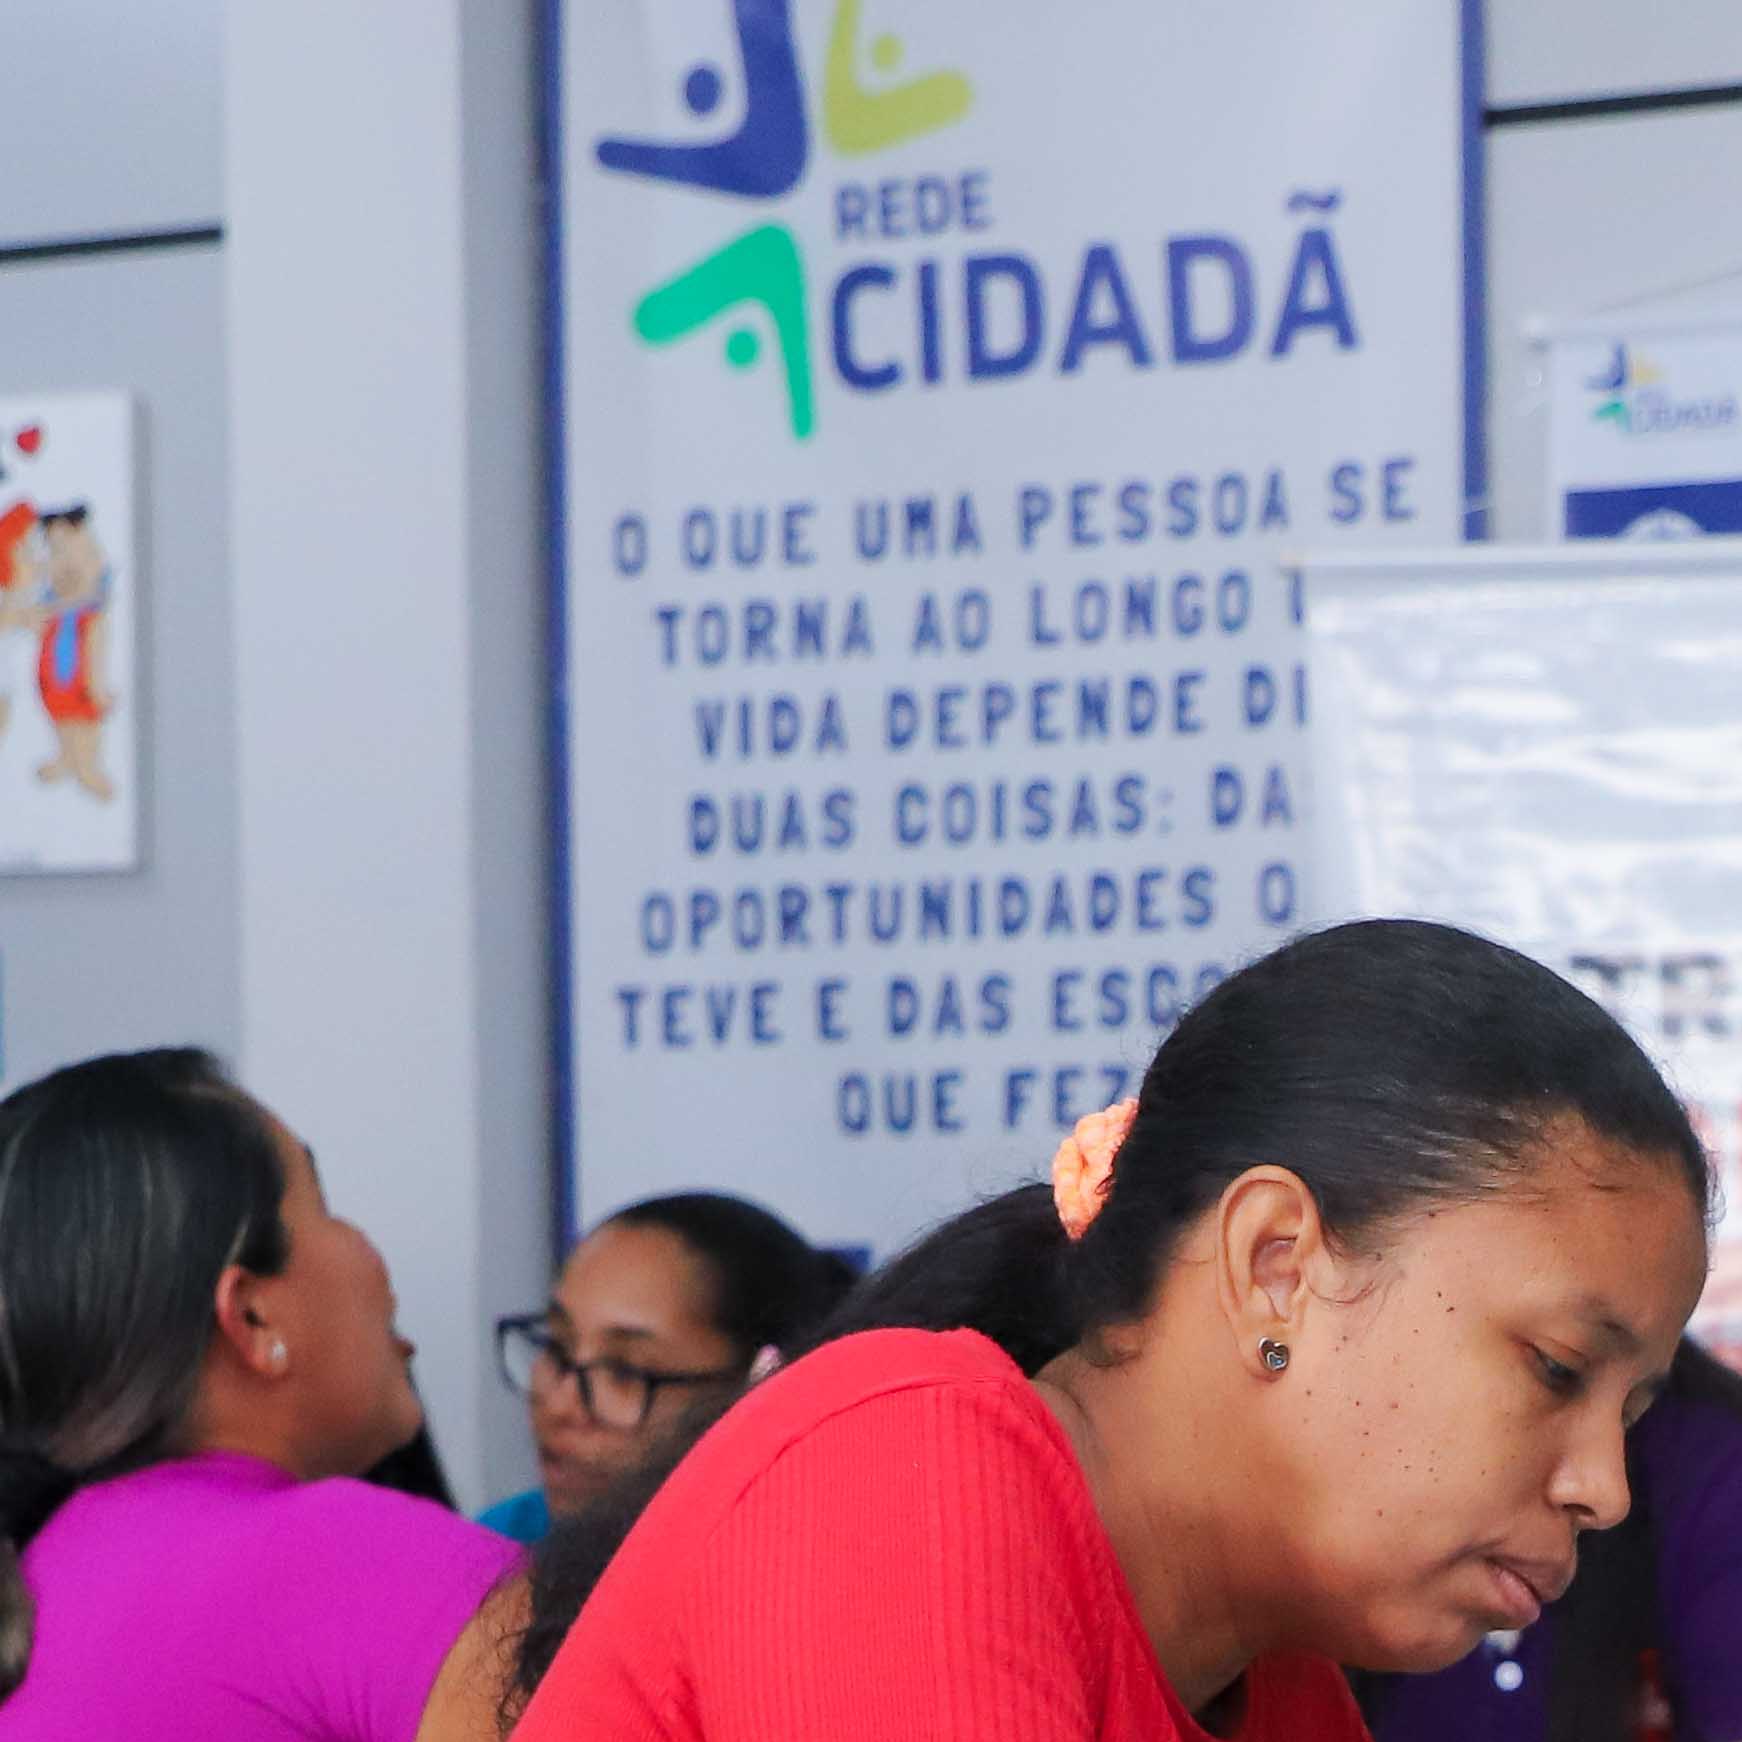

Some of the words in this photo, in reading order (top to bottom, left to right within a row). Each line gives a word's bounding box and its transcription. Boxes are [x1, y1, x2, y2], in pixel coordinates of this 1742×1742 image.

[834, 172, 995, 243] REDE
[829, 188, 1361, 395] CIDADÃ
[613, 509, 648, 577] O
[681, 497, 819, 571] QUE
[855, 488, 983, 562] UMA
[1017, 468, 1290, 552] PESSOA
[1328, 457, 1416, 524] SE
[655, 594, 876, 669] TORNA
[912, 586, 992, 656] AO
[1031, 568, 1252, 645] LONGO
[695, 688, 847, 760] VIDA
[887, 670, 1206, 754] DEPENDE
[688, 786, 855, 855] DUAS
[895, 772, 1177, 848] COISAS:
[640, 865, 1215, 955] OPORTUNIDADES
[615, 978, 782, 1050] TEVE
[814, 974, 851, 1043] E
[885, 965, 1013, 1042] DAS
[835, 1067, 965, 1137] QUE
